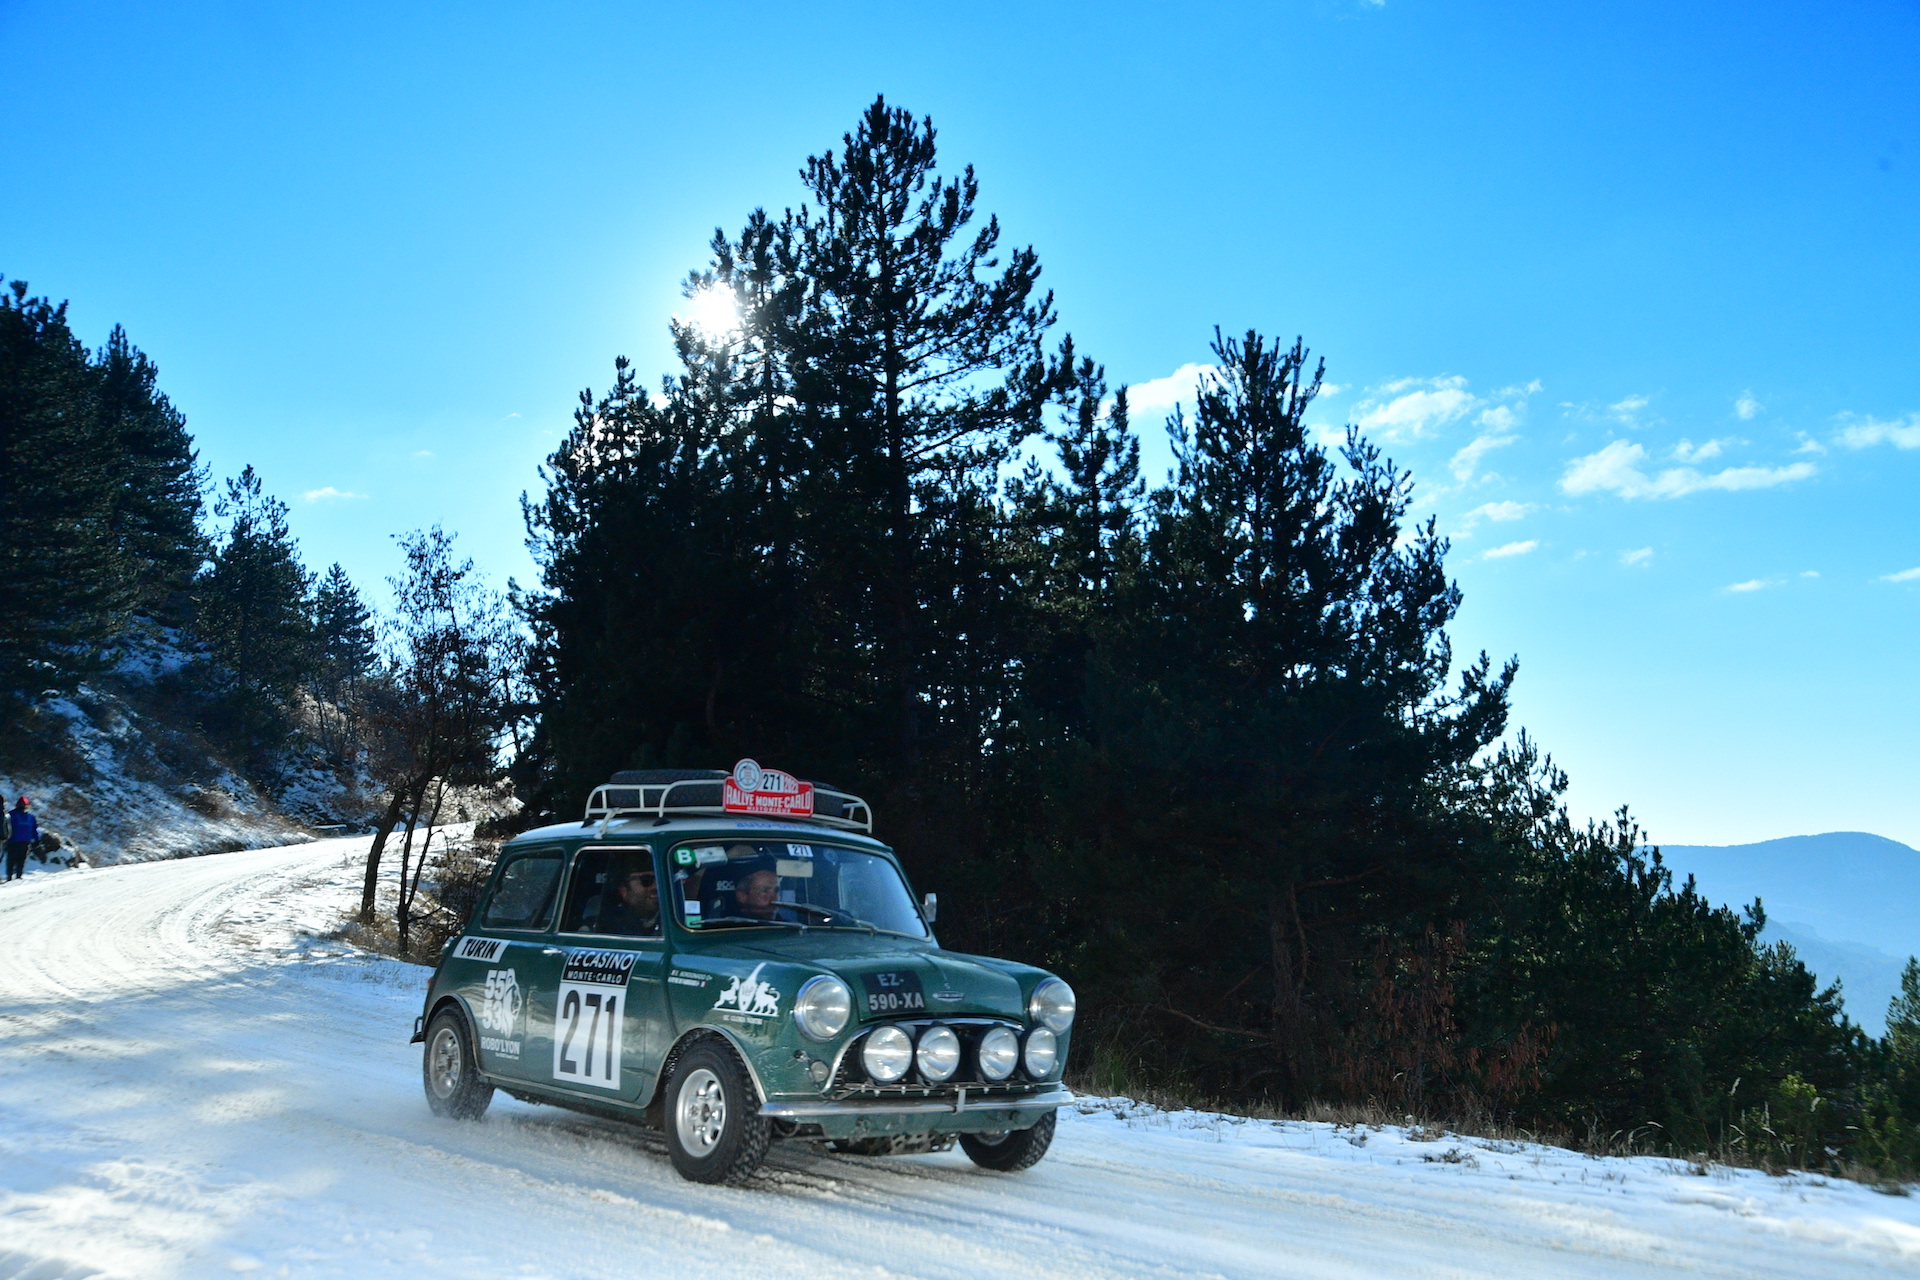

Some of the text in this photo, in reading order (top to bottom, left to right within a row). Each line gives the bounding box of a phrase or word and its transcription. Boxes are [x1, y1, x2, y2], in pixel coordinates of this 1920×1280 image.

[763, 774, 781, 791] 271
[726, 785, 811, 810] RALLYE MONTE-CARLO
[677, 850, 692, 864] B
[792, 846, 809, 856] 271
[461, 938, 501, 959] TURIN
[568, 950, 634, 970] LE CASINO
[484, 969, 507, 1000] 55
[567, 970, 622, 984] MONTE-CARLO
[868, 992, 925, 1011] 590-XA
[482, 1000, 503, 1031] 53
[559, 989, 617, 1081] 271
[481, 1036, 521, 1055] ROBO'LYON
